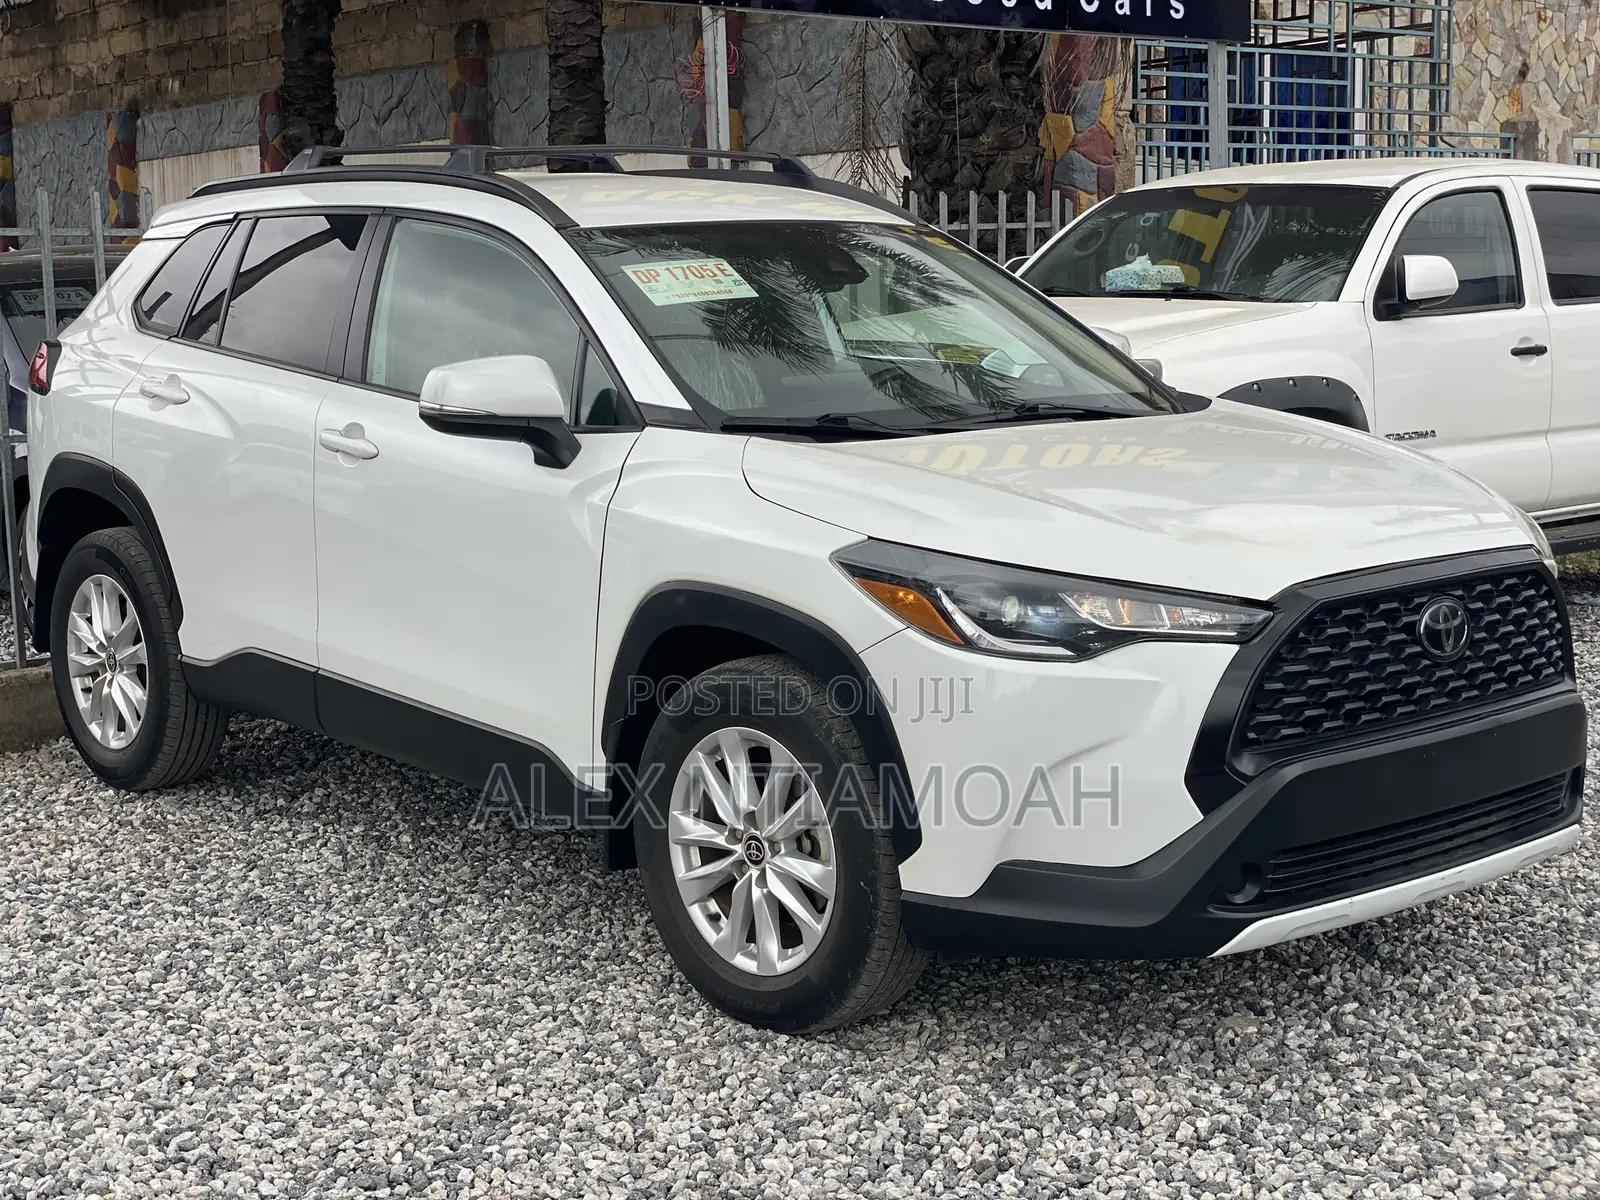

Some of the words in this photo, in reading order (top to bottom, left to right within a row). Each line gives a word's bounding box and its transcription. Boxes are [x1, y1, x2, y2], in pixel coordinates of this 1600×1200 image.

[631, 268, 661, 284] DP
[664, 264, 718, 281] 1705
[714, 263, 734, 278] E
